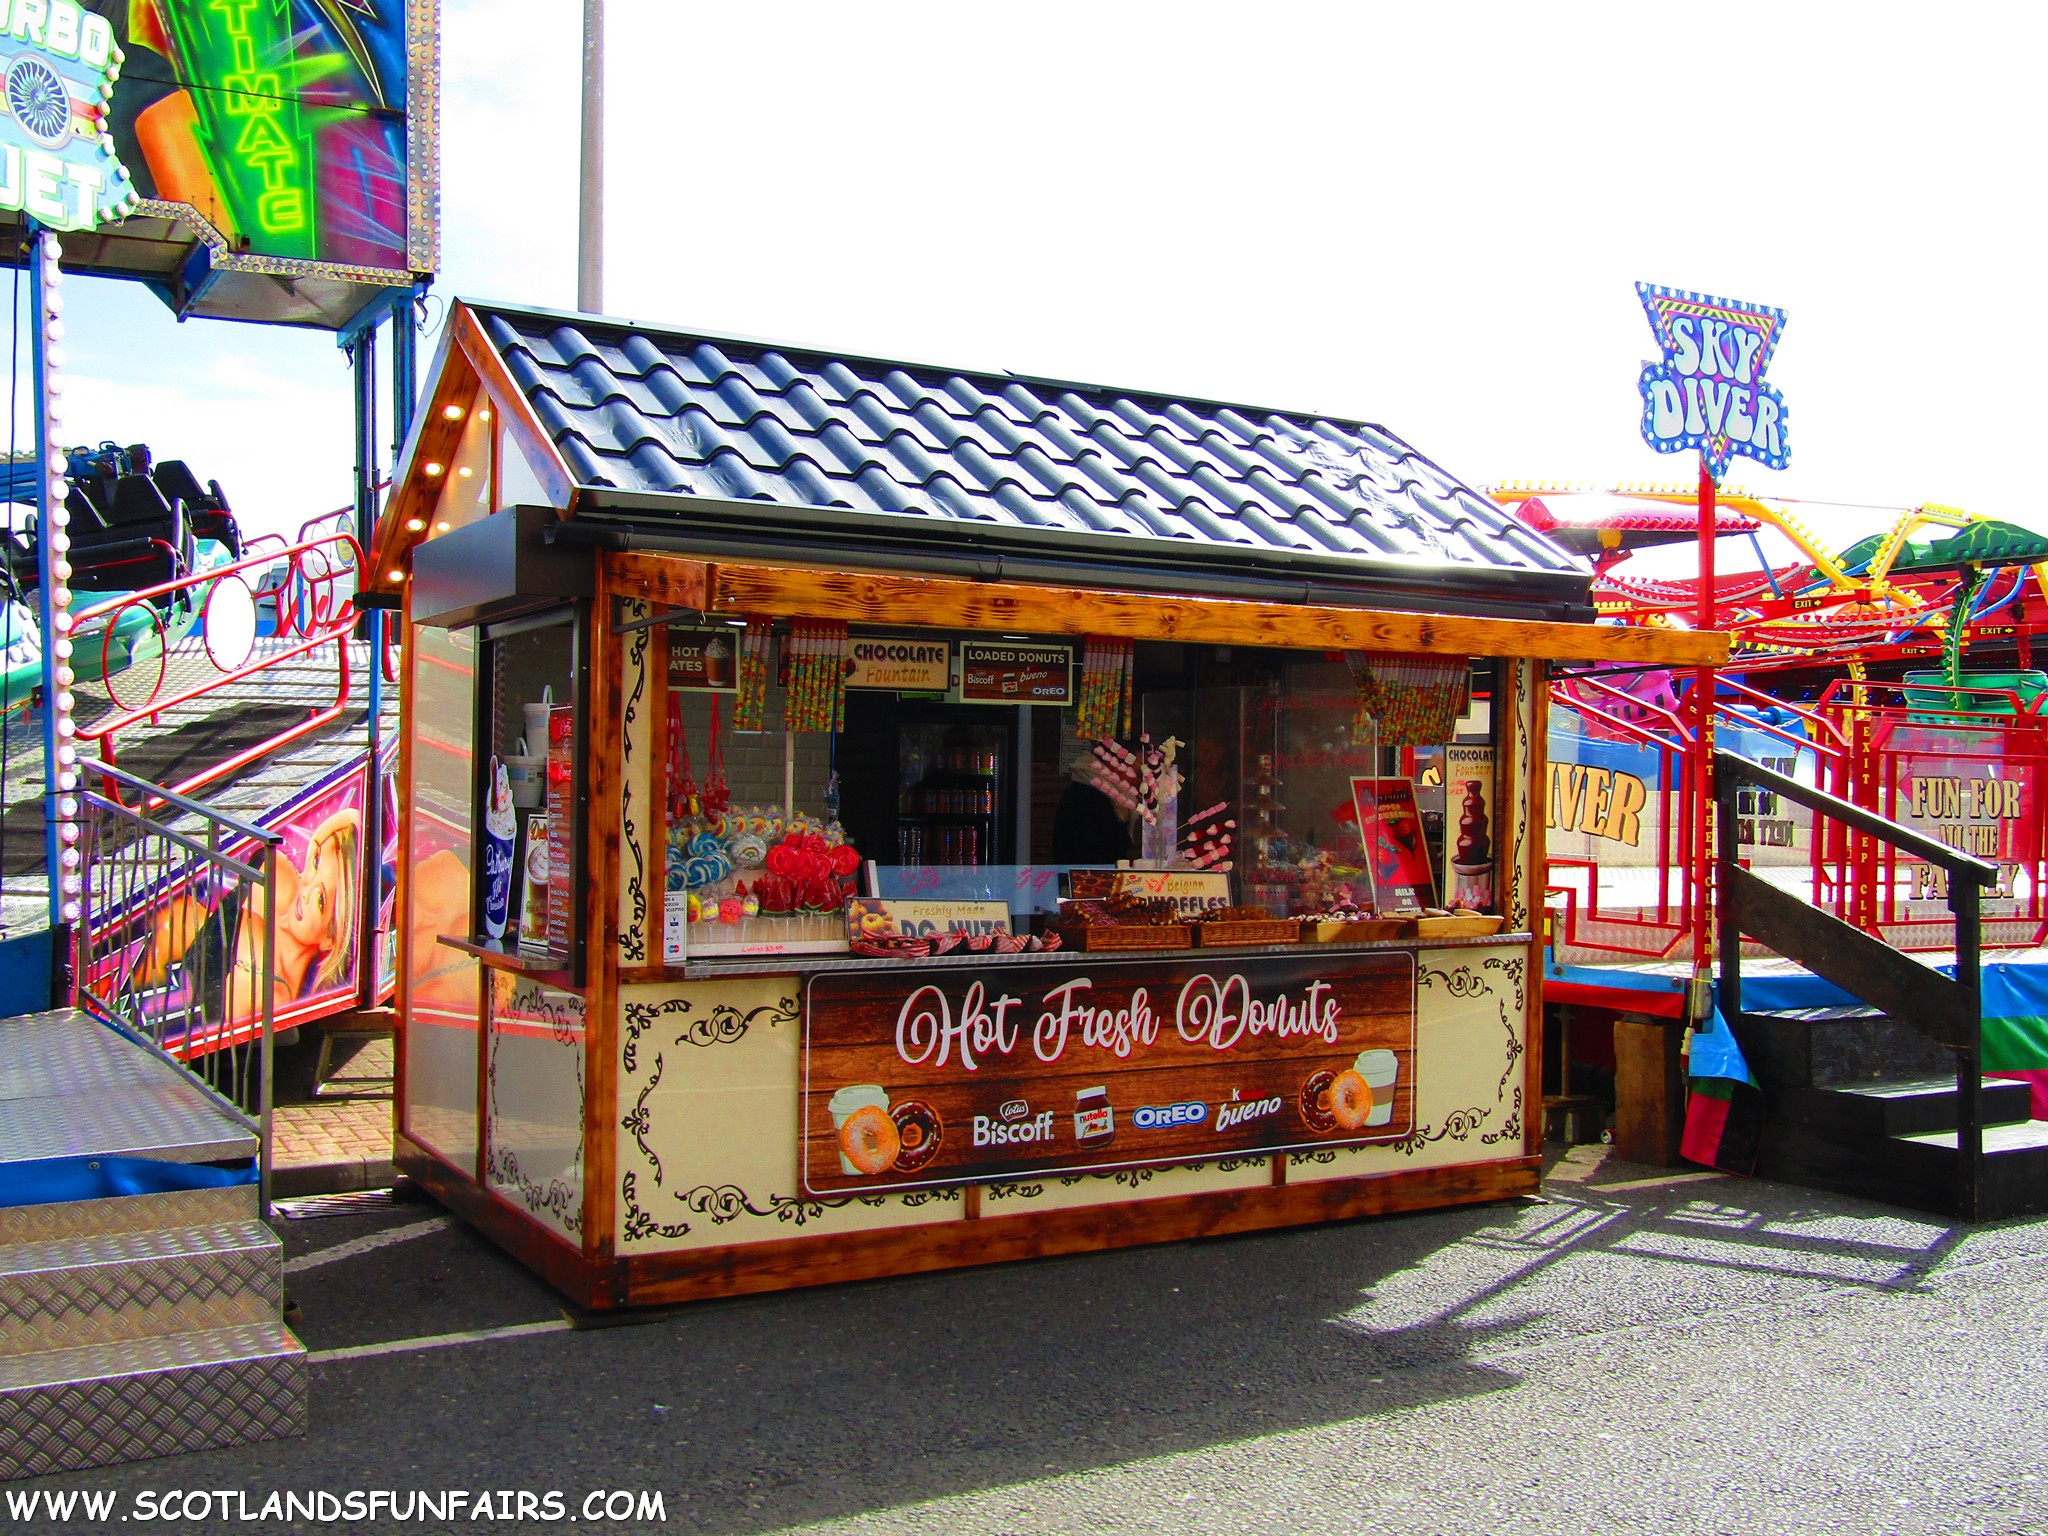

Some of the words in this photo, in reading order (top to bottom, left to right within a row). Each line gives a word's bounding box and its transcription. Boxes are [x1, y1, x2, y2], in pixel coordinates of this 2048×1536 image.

[0, 143, 102, 227] JET
[1672, 317, 1761, 384] SKY
[1650, 378, 1782, 456] DIVER
[1794, 600, 1812, 608] EXIT
[1980, 627, 2002, 635] EXIT
[671, 646, 700, 657] HOT
[854, 644, 944, 664] CHOCOLATE
[968, 650, 1015, 662] LOADED
[1019, 652, 1065, 664] DONUTS
[866, 664, 931, 683] Fountain
[967, 673, 994, 684] Biscoff
[1020, 671, 1048, 682] bueno
[1032, 687, 1065, 696] OREO
[1705, 714, 1714, 776] EXIT
[1862, 726, 1870, 784] EXIT
[1910, 776, 1961, 818] FUN
[1969, 778, 2021, 818] FOR
[1705, 798, 1713, 860] KEEP
[1969, 824, 1997, 858] THE
[1167, 879, 1205, 895] Belgian
[1909, 863, 2020, 900] FALY
[1394, 888, 1415, 897] MILK
[913, 905, 952, 918] Freshly
[957, 905, 985, 915] Made
[1704, 876, 1713, 955] CLEAR
[896, 981, 1022, 1070] Hot
[1033, 977, 1161, 1062] Fresh
[1176, 973, 1342, 1050] Donuts
[1005, 1104, 1025, 1116] Lotus
[1079, 1108, 1108, 1124] nutella
[1134, 1103, 1206, 1125] OREO
[1215, 1096, 1281, 1132] bueno
[973, 1110, 1054, 1146] Biscoff
